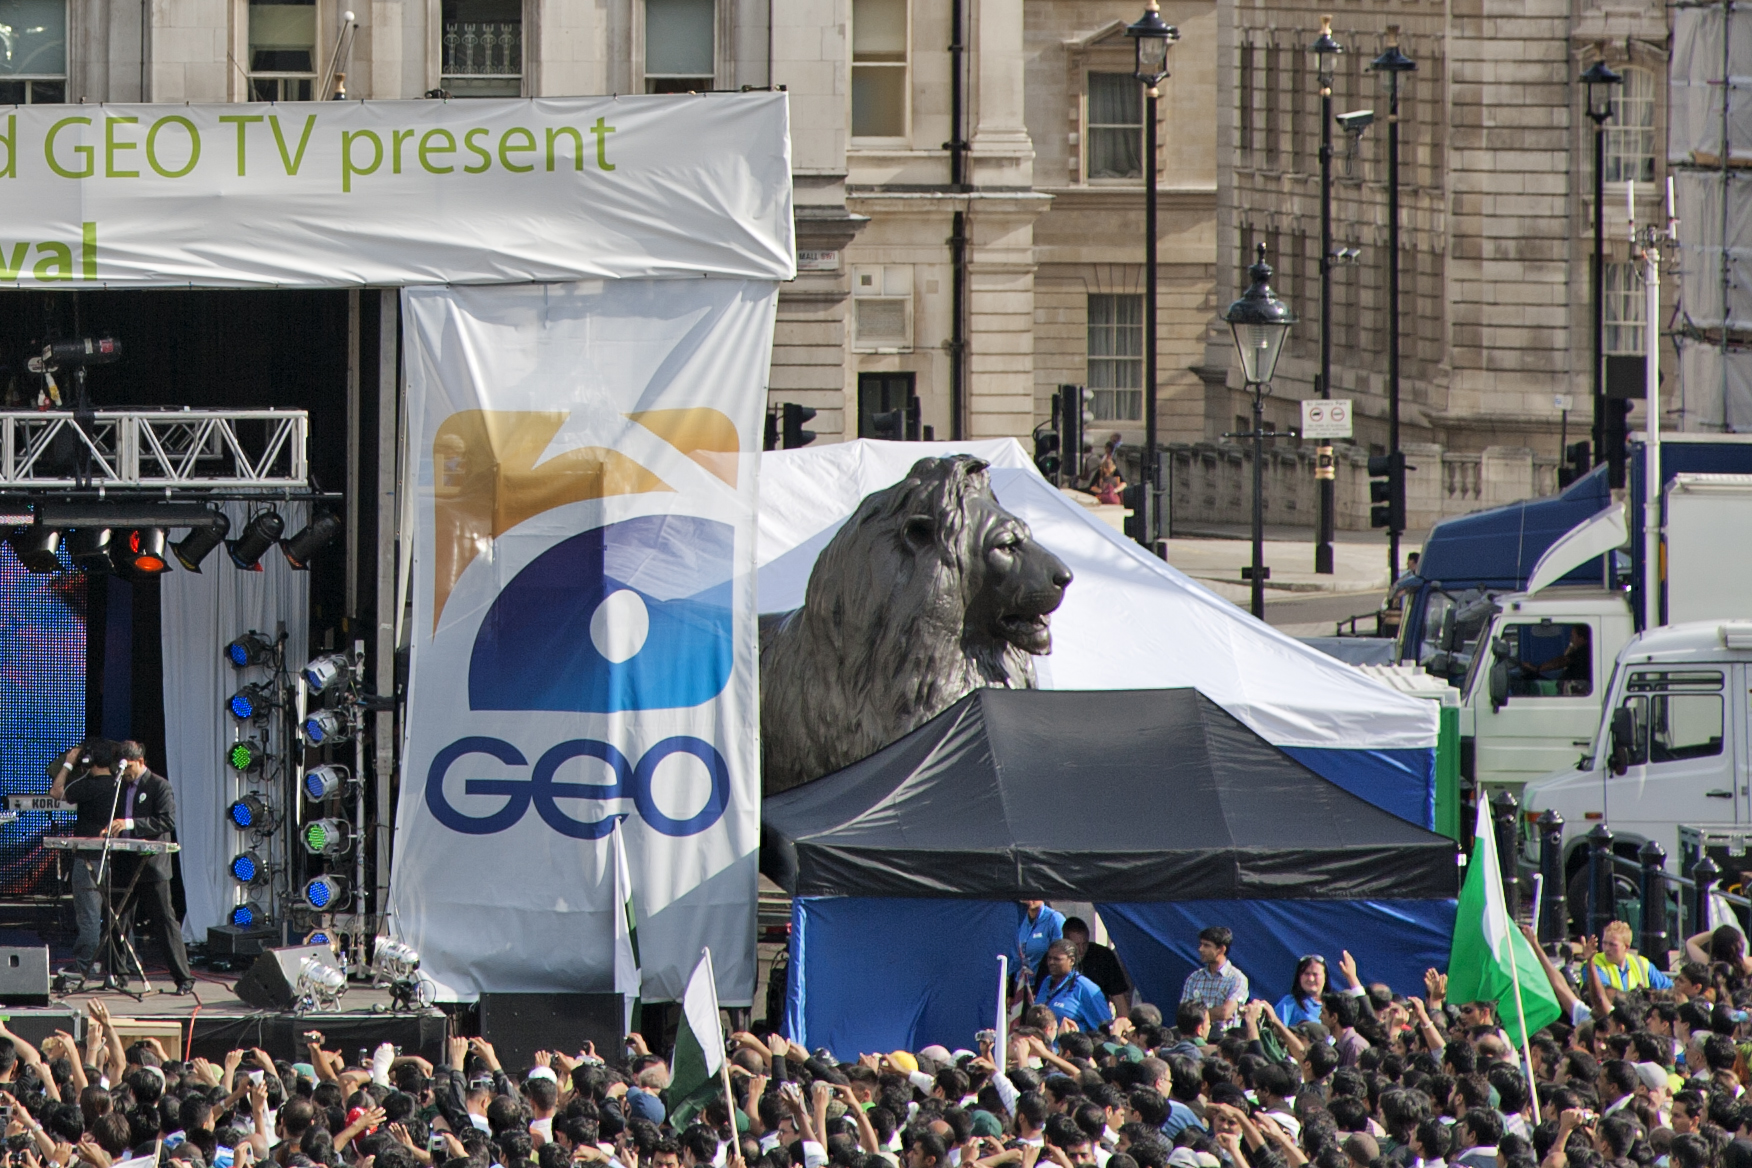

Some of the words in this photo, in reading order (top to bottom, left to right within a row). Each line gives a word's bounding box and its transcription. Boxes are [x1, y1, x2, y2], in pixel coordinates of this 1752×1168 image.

[44, 115, 201, 179] GEO
[218, 115, 317, 176] TV
[341, 116, 616, 193] present
